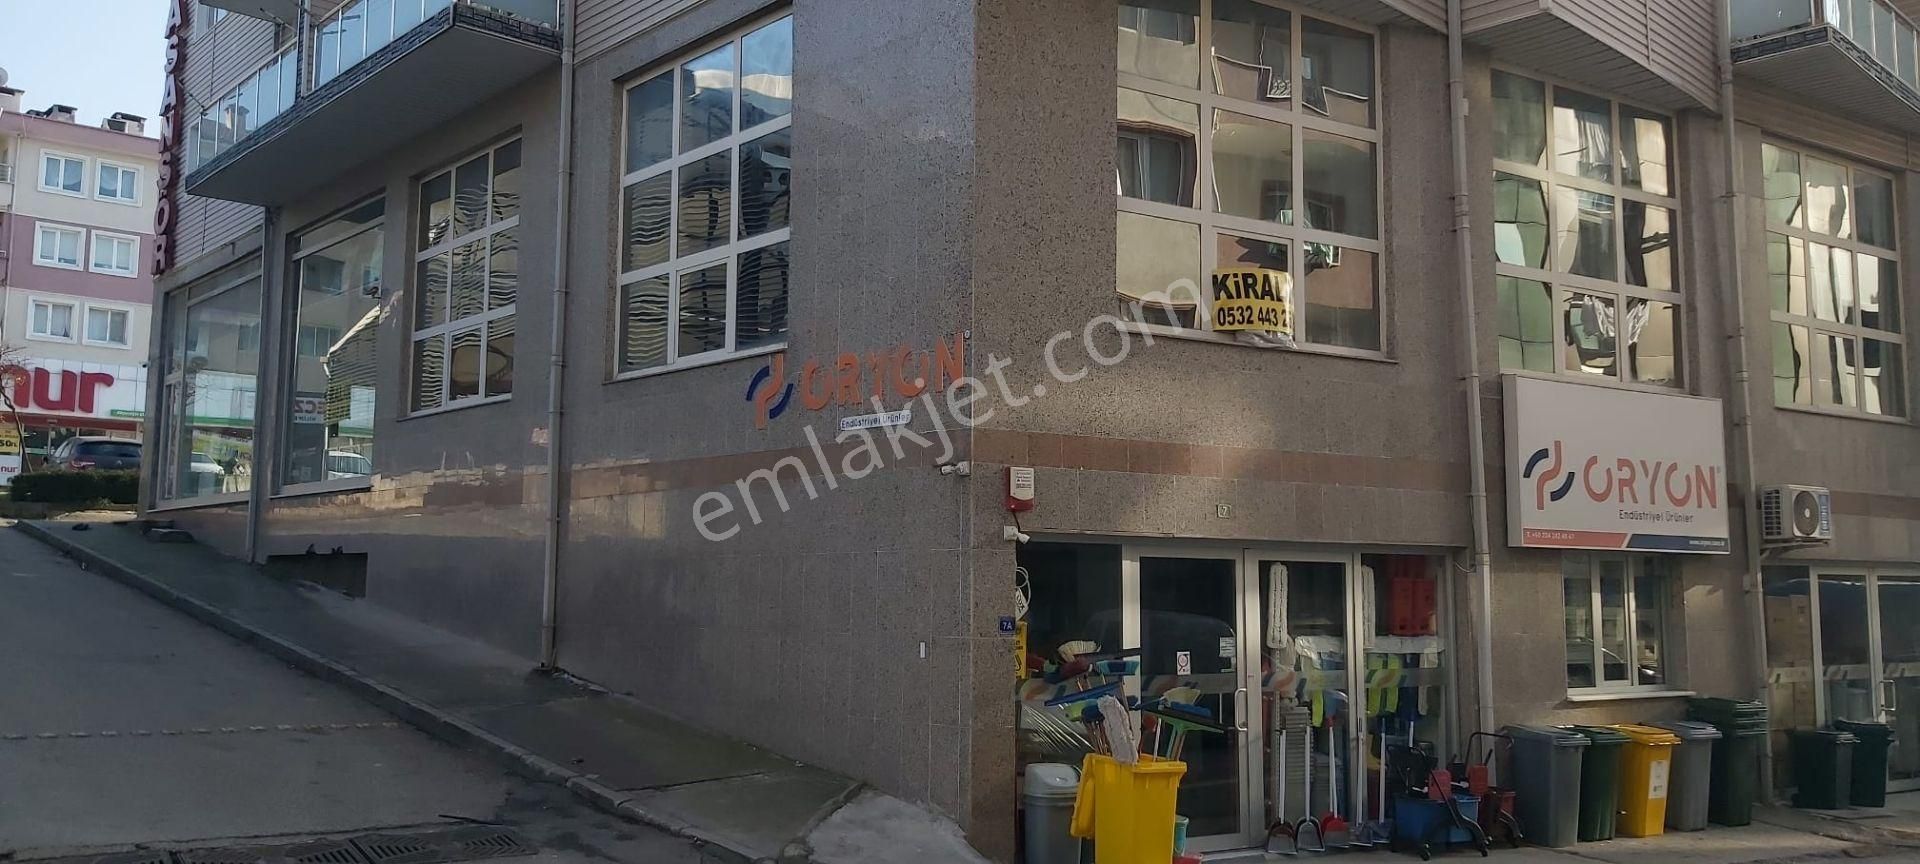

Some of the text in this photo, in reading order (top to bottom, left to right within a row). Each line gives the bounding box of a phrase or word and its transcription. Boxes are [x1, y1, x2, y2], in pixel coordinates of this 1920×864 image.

[1217, 306, 1254, 327] 0532
[1258, 307, 1279, 327] 443
[802, 333, 965, 411] ORYON
[1583, 455, 1717, 509] ORYON
[1619, 509, 1694, 523] Endüstriyel Ürünler
[1001, 620, 1013, 631] 7A
